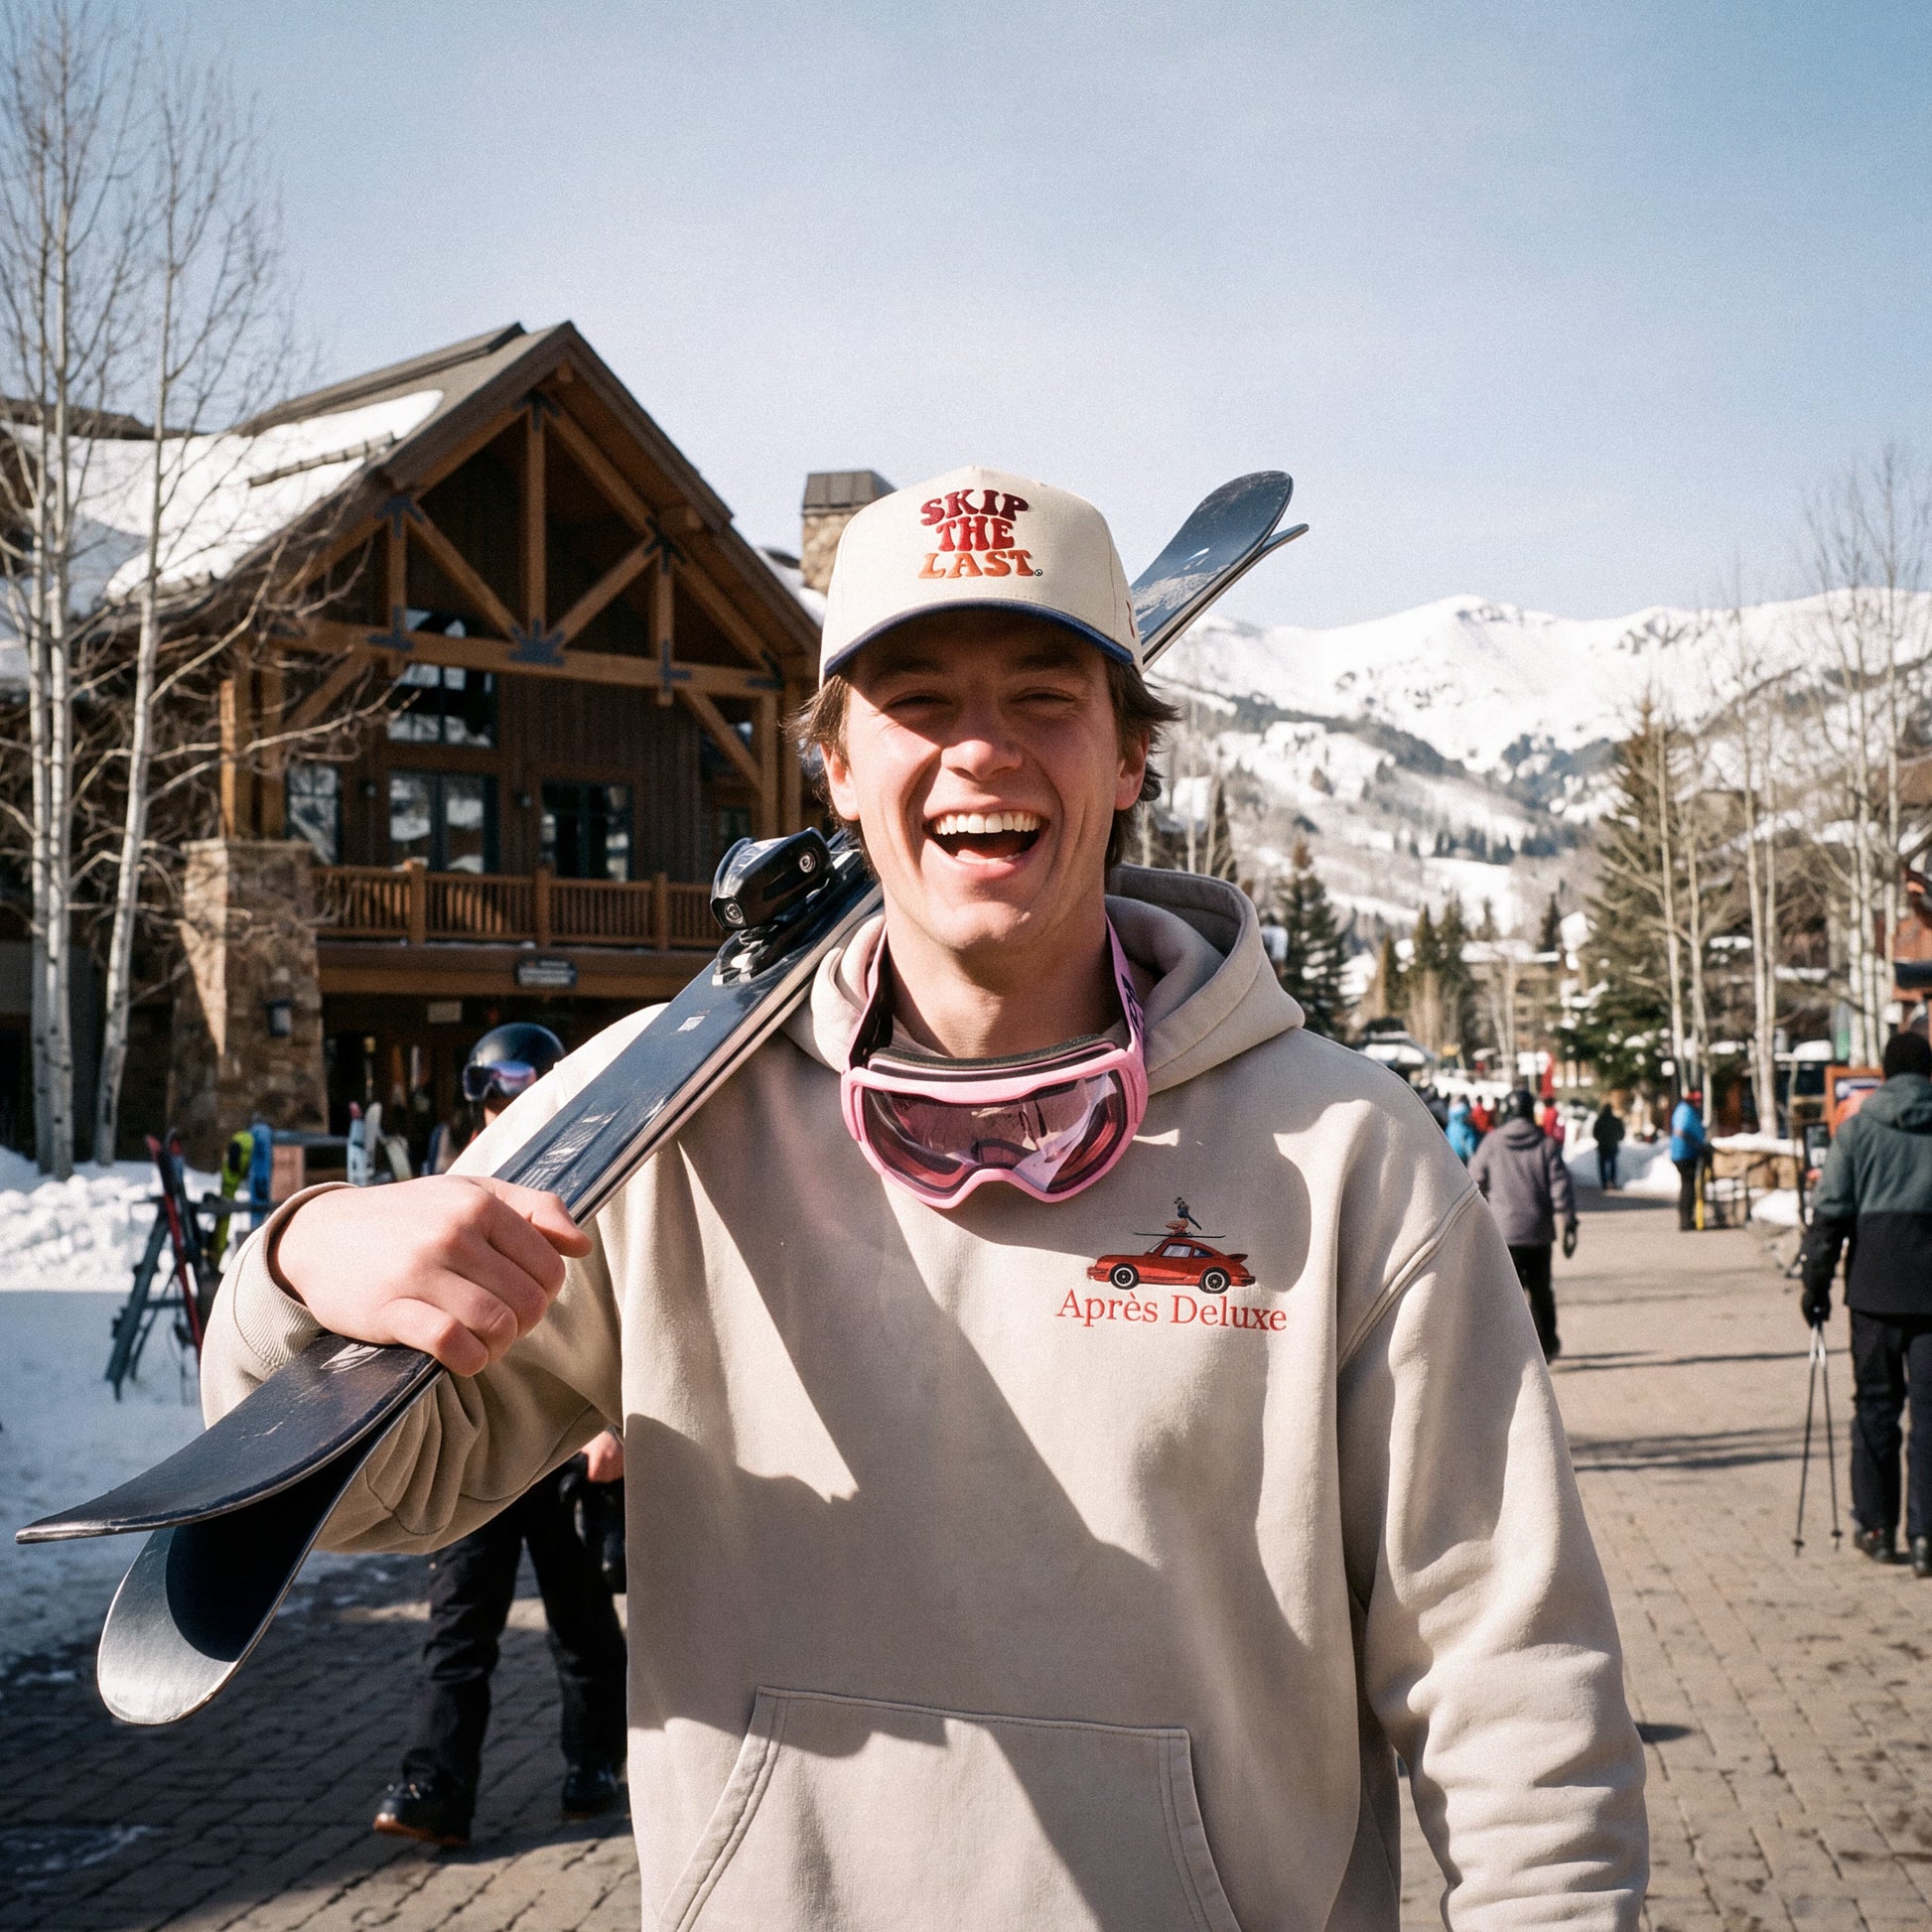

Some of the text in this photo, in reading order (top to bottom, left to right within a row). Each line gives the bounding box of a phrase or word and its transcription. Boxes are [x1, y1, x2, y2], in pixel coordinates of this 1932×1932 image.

[920, 488, 1030, 526] SKIP
[935, 515, 1015, 552] THE
[1056, 1288, 1287, 1332] Après Deluxe
